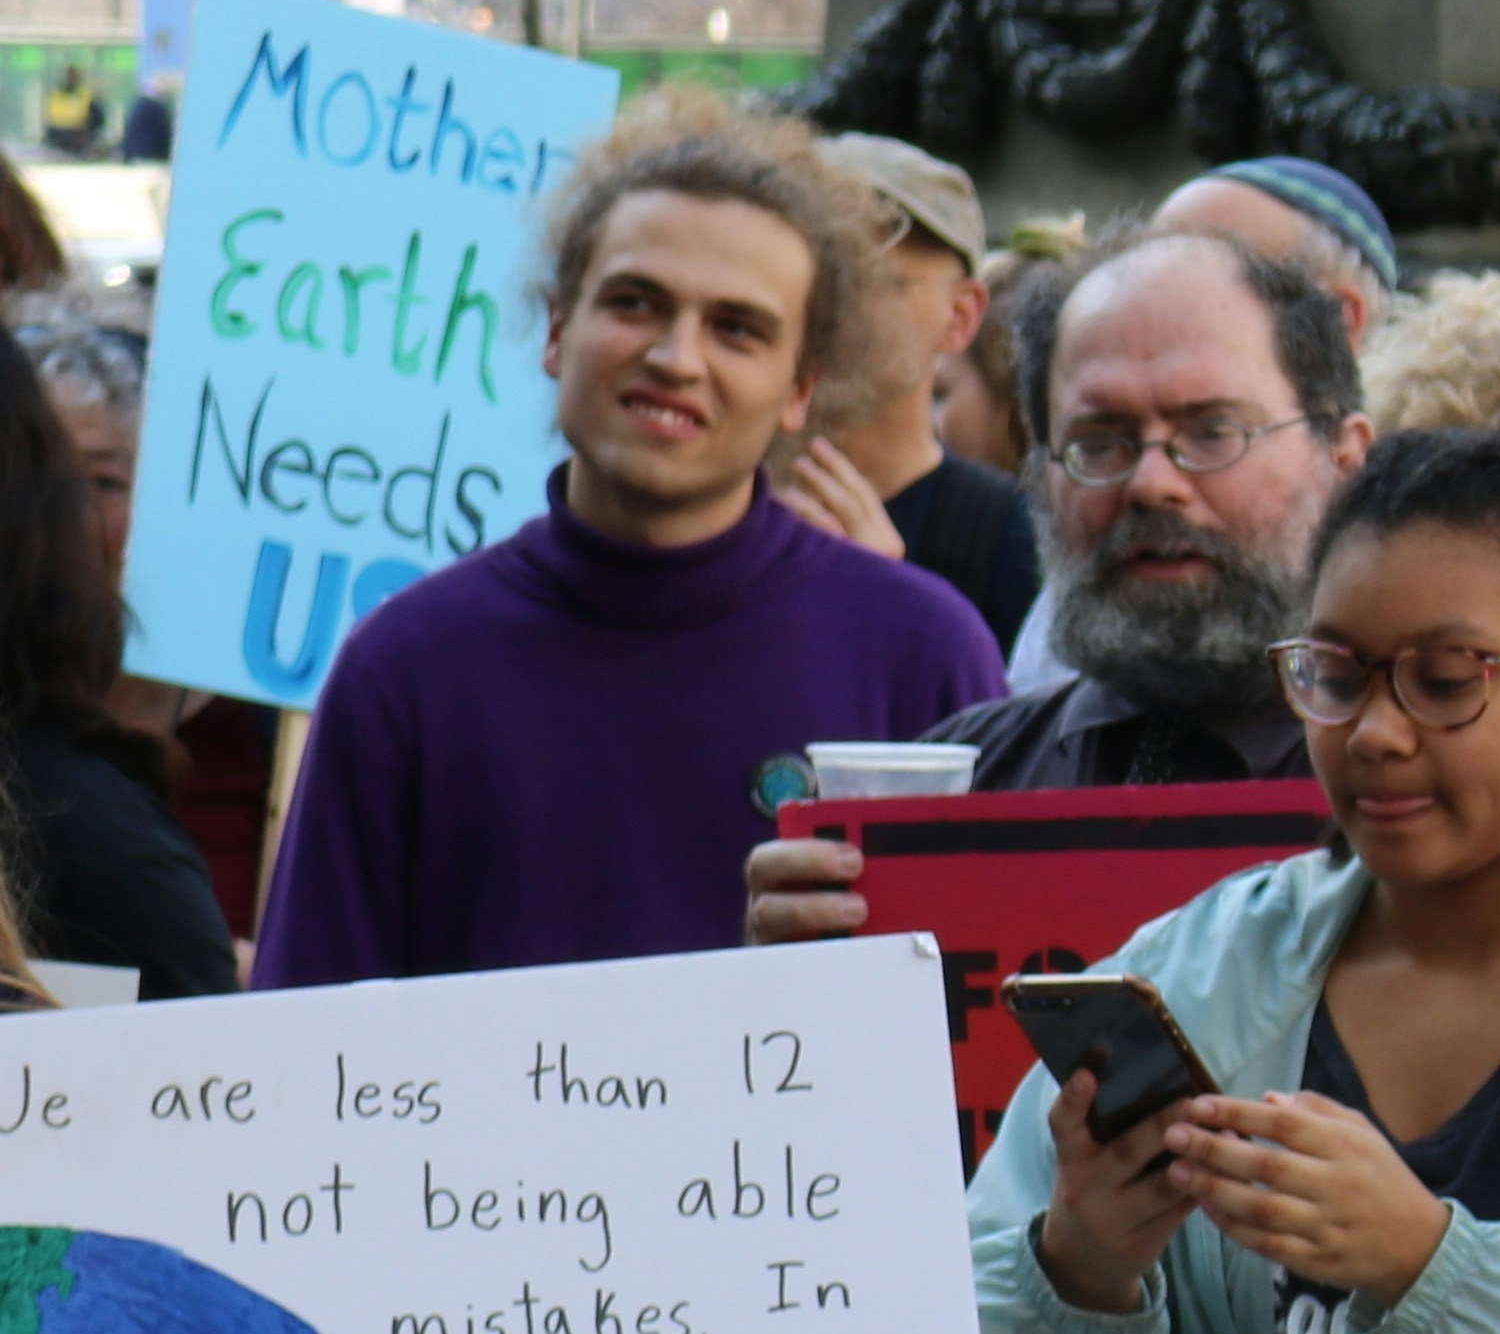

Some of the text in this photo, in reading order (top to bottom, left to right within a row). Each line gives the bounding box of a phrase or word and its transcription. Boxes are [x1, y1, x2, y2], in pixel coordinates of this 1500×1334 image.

[218, 30, 578, 197] Mother
[211, 209, 497, 406] Earth
[189, 373, 503, 559] Needs
[151, 1074, 256, 1123] are
[335, 1053, 442, 1124] less
[526, 1042, 667, 1109] than
[744, 1031, 813, 1094] 12
[227, 1140, 841, 1272] not being able
[766, 1261, 850, 1312] In
